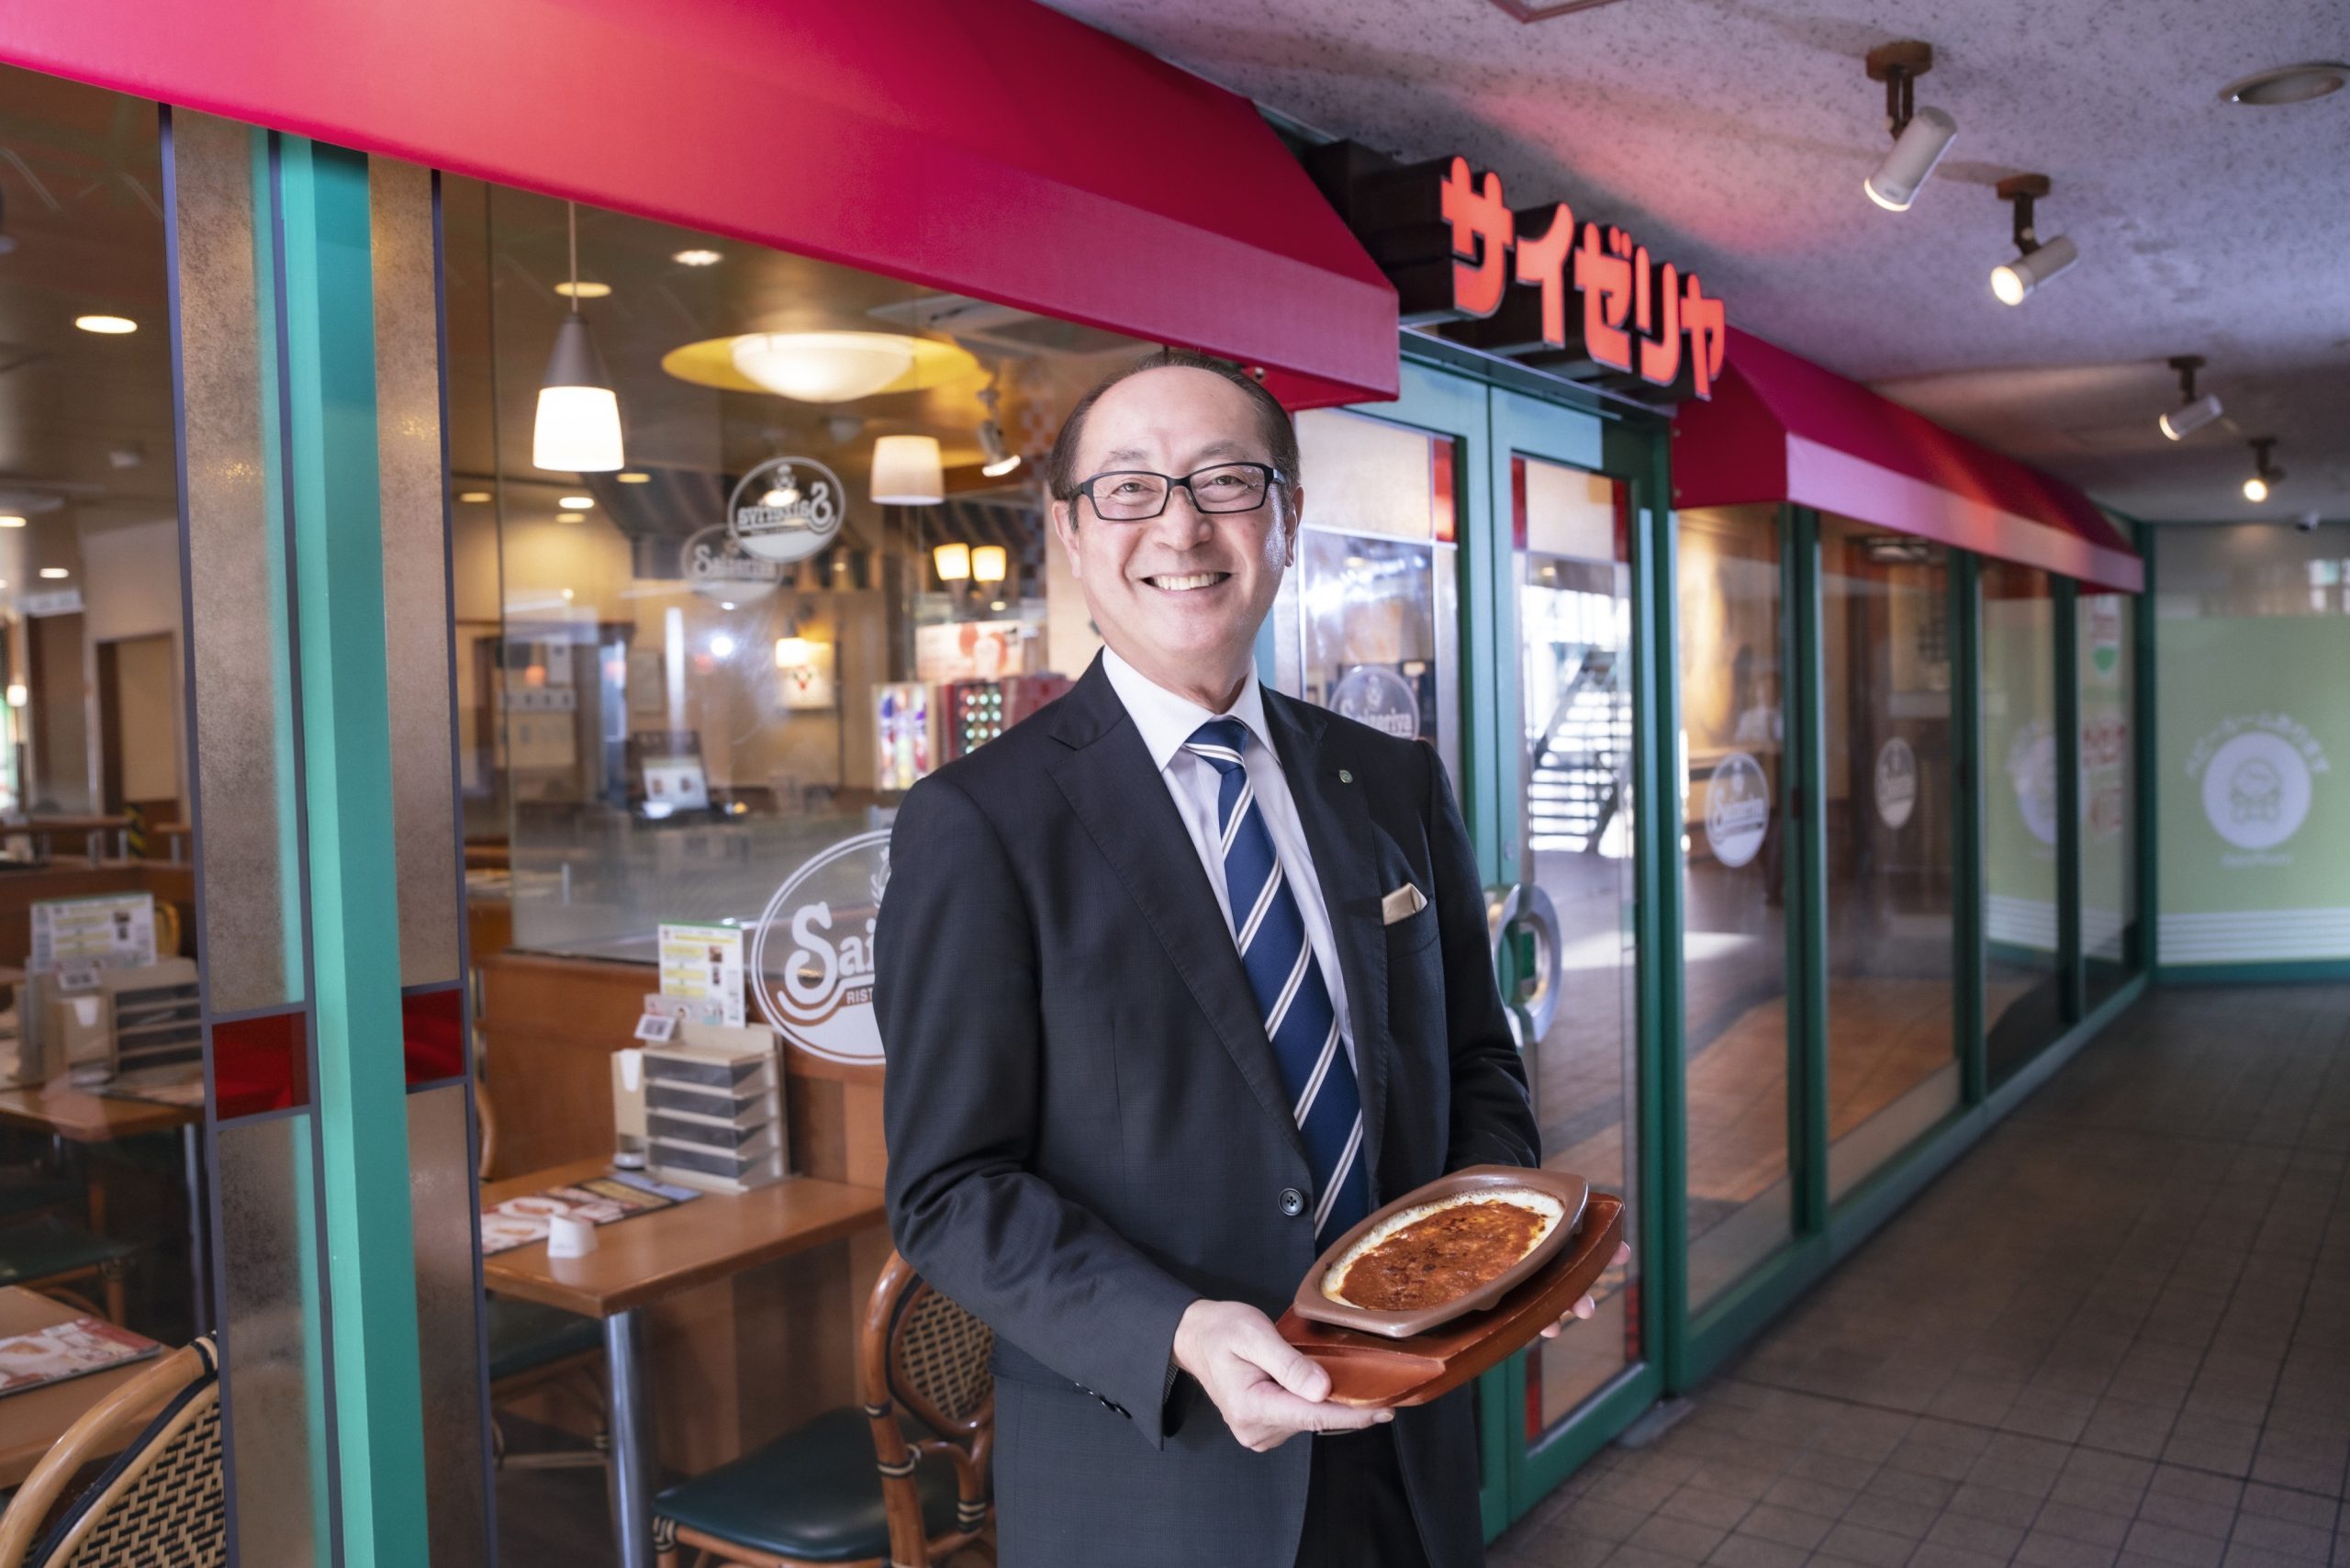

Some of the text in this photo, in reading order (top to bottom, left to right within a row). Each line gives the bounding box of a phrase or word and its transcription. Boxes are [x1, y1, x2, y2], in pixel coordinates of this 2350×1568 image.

[1440, 156, 1725, 400] サイゼリヤ
